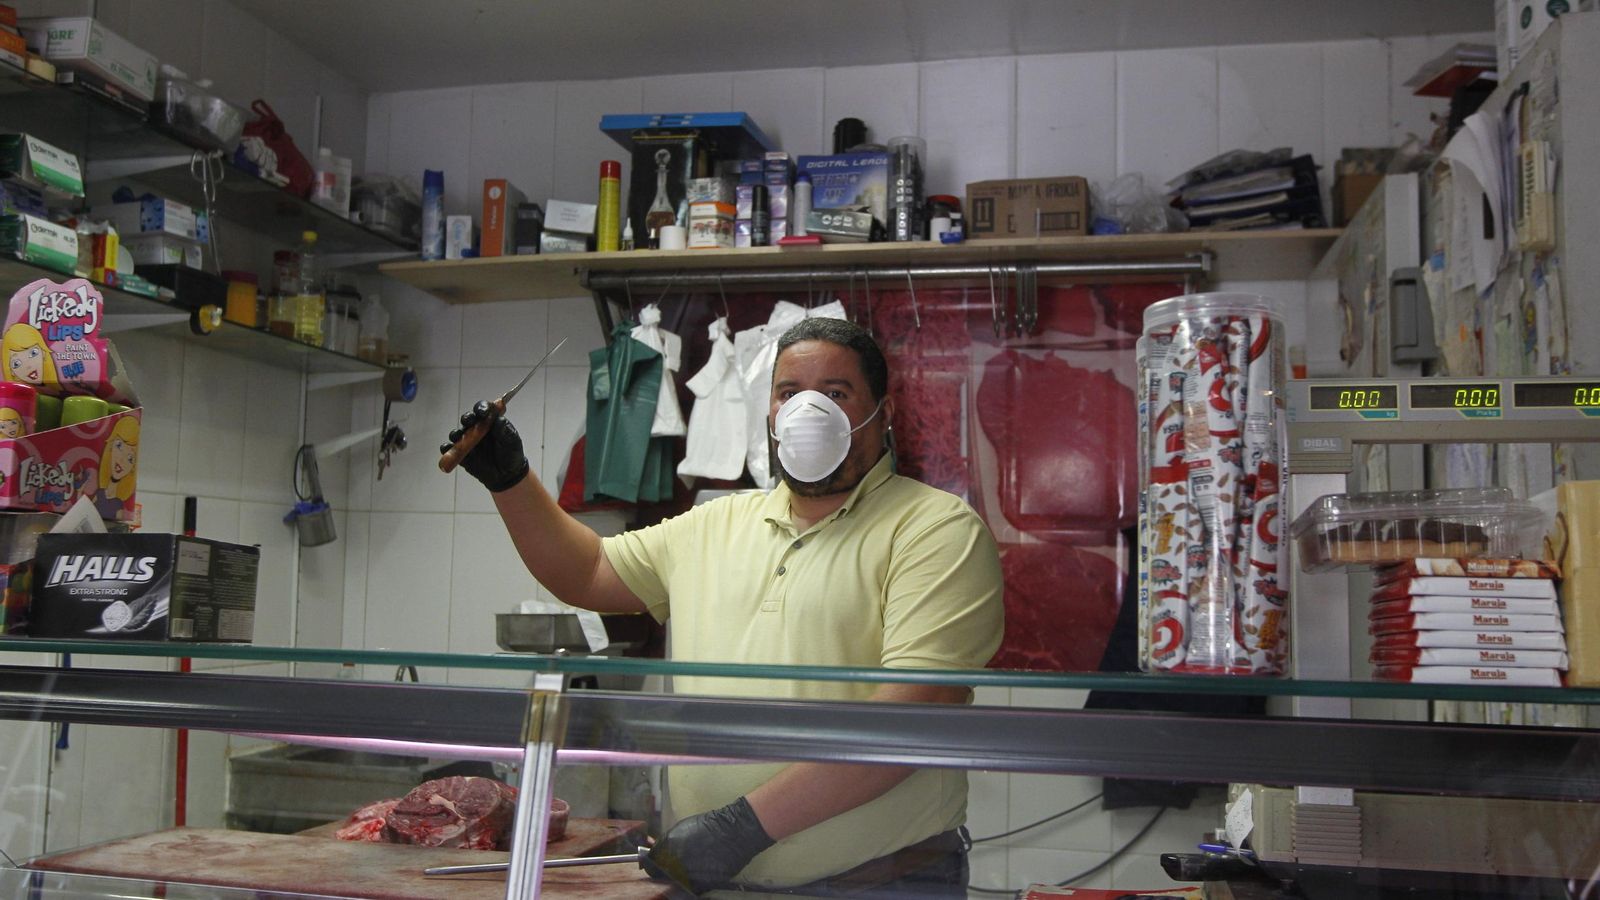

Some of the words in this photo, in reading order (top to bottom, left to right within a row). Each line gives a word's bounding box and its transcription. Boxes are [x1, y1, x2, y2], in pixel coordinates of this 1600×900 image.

[806, 160, 849, 169] DIGITAL
[29, 286, 97, 334] Lickedy
[65, 344, 89, 352] PAINT
[56, 352, 71, 361] THE
[73, 352, 96, 361] TOWN
[1339, 391, 1381, 408] 0.00
[1454, 389, 1498, 407] 0.00
[1303, 438, 1337, 448] DIBAL
[20, 457, 74, 500] Lickedy
[47, 555, 157, 586] HALLS
[1469, 580, 1504, 590] Maruja
[69, 587, 95, 596] EXTRA
[95, 588, 129, 596] STRONG
[1471, 598, 1507, 609] Maruja
[1473, 615, 1509, 625] Maruja
[1477, 634, 1513, 645] Maruja
[1479, 651, 1516, 662] Maruja
[1470, 669, 1507, 680] Maruja
